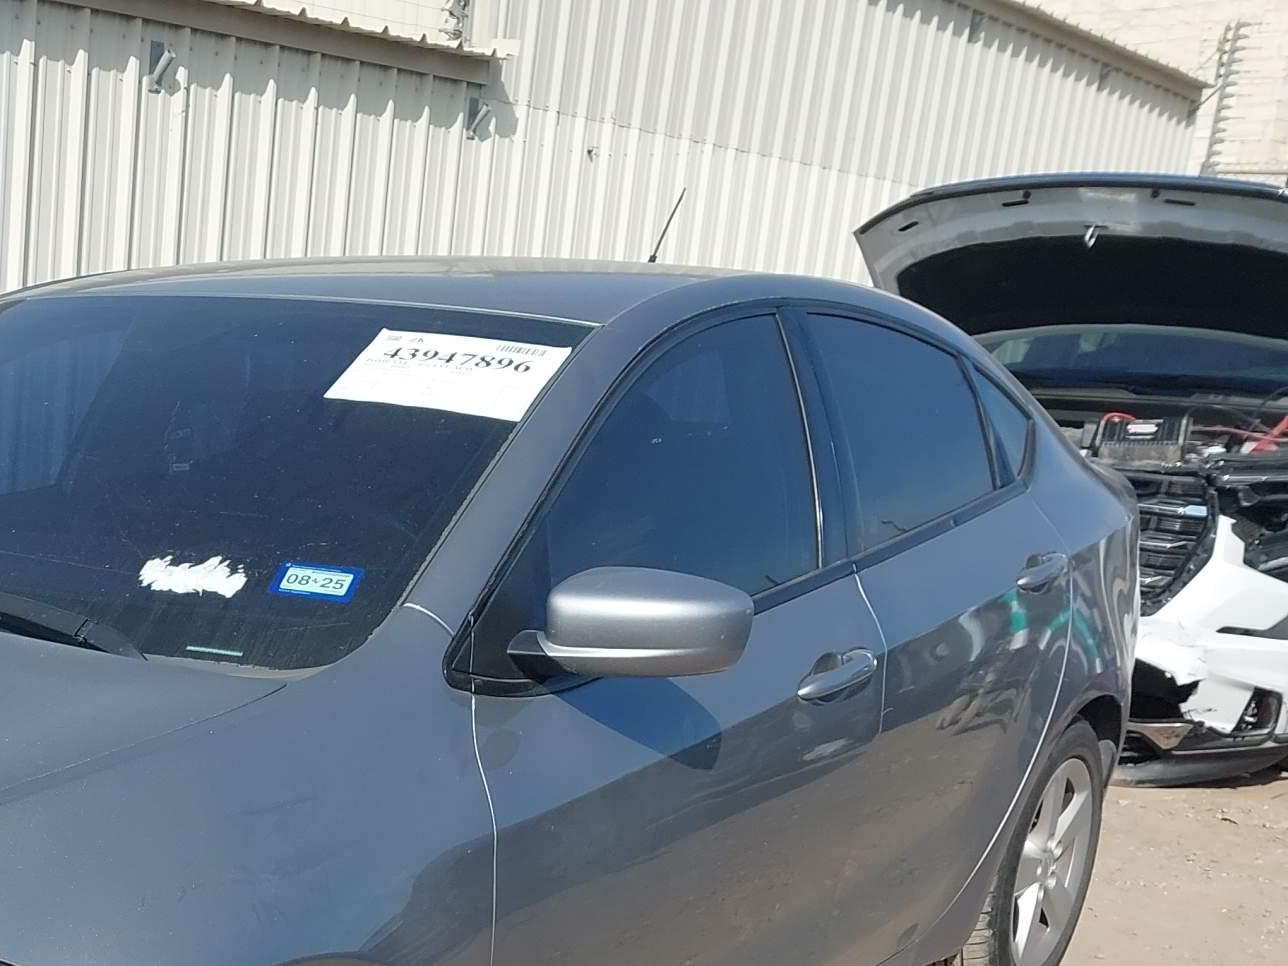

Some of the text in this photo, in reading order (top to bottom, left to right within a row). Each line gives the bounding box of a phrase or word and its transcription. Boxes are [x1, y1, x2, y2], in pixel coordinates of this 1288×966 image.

[383, 346, 534, 374] 43947896
[286, 573, 347, 590] 08 25
